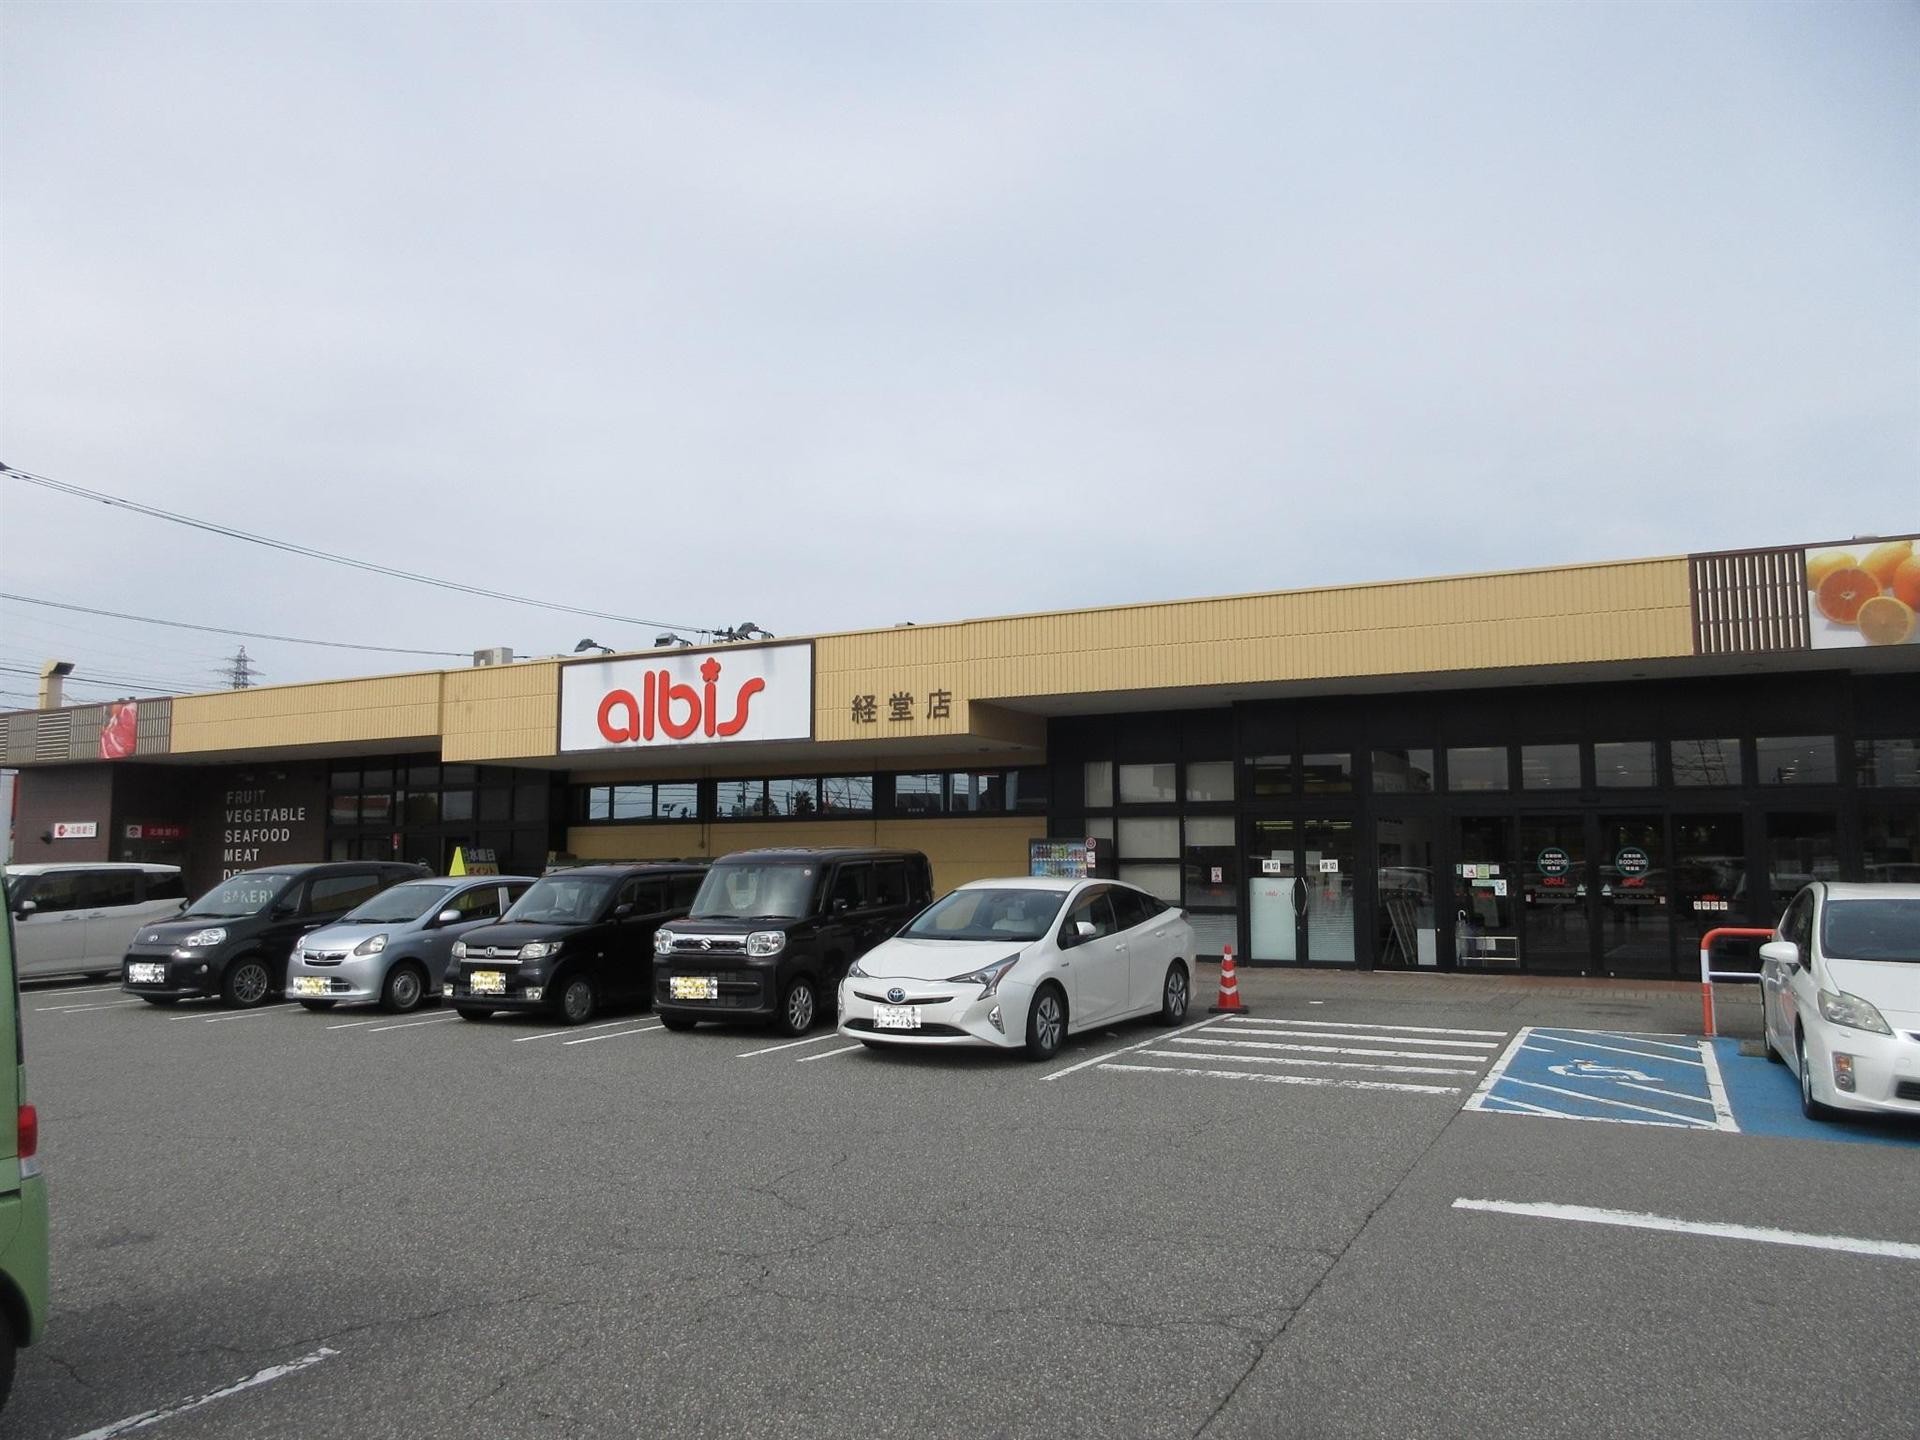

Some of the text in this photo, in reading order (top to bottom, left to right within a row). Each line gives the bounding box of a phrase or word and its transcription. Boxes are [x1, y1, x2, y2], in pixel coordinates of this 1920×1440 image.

[597, 657, 765, 743] albis
[851, 688, 953, 724] 経堂店
[226, 790, 266, 804] FRUIT
[225, 807, 306, 822] VEGETABLE
[224, 829, 291, 843] SEAFOOD
[223, 848, 261, 862] MEAT
